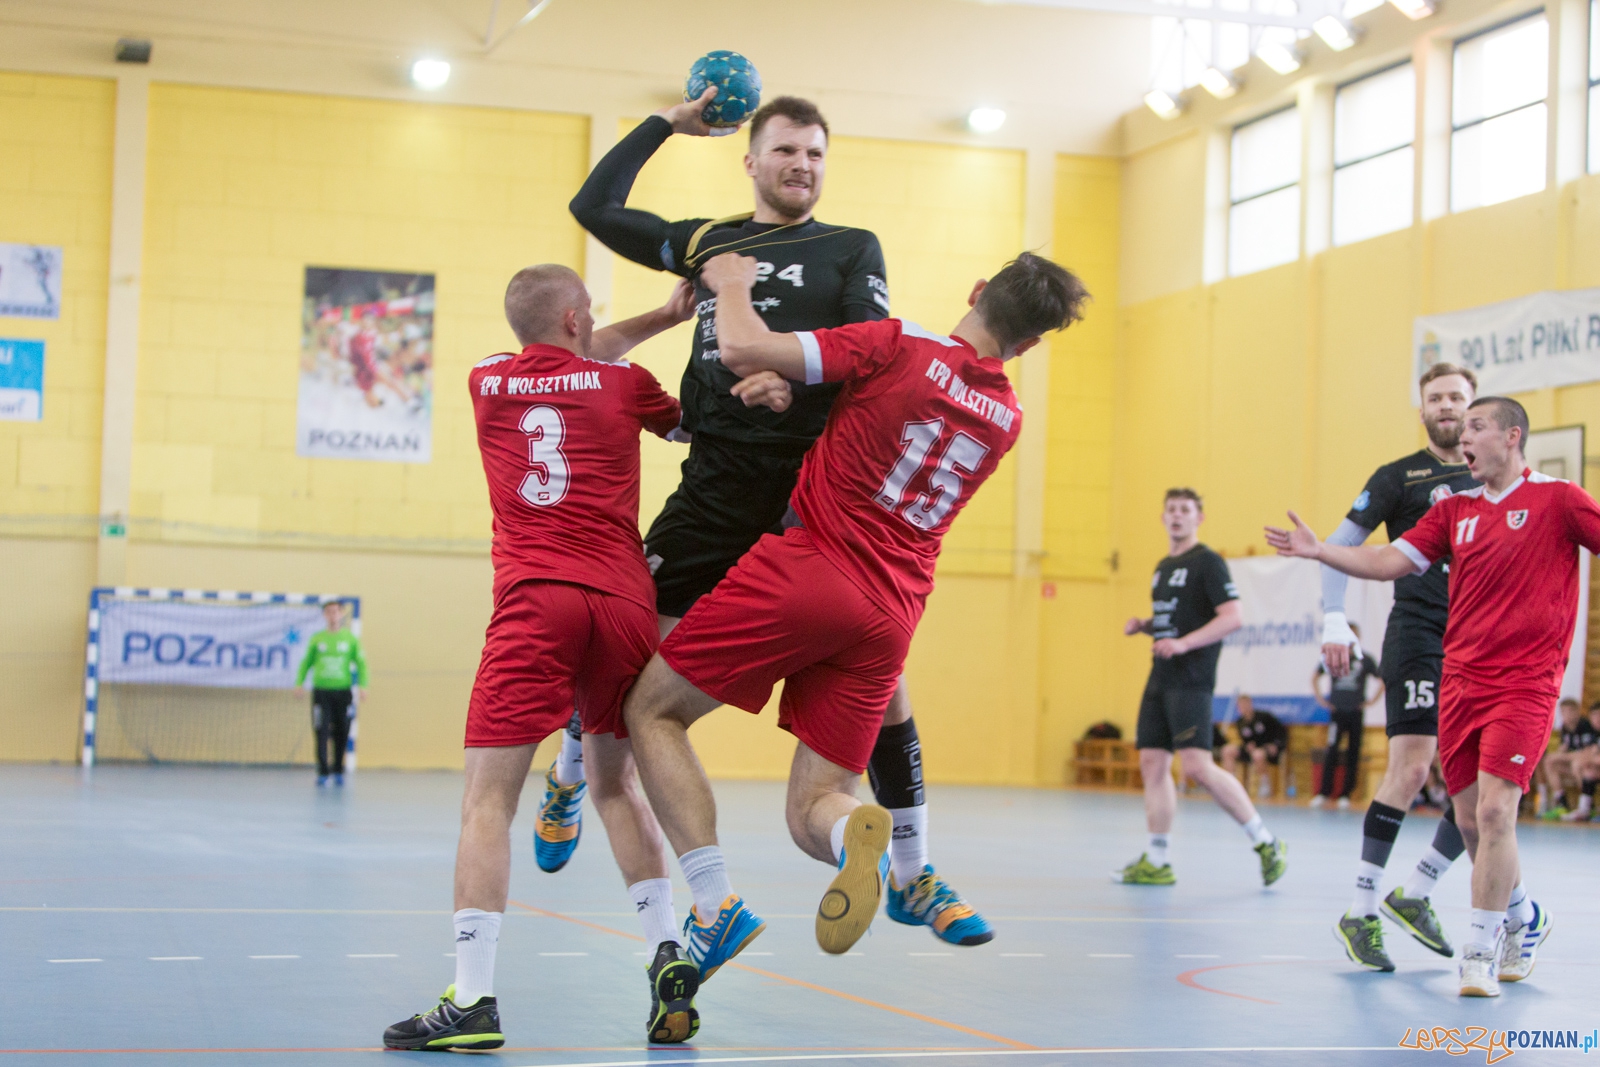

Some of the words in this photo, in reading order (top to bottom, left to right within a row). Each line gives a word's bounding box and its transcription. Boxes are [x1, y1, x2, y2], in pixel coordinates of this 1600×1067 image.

[755, 261, 805, 287] 24
[1459, 336, 1486, 370] 90
[480, 375, 502, 396] KPR
[507, 371, 602, 395] WOLSZTYNIAK
[925, 357, 951, 389] KPR
[947, 373, 1016, 433] WOLSZTYNIAK
[516, 403, 571, 507] 3
[871, 416, 991, 531] 15
[1455, 515, 1480, 545] 11
[1404, 679, 1435, 710] 15
